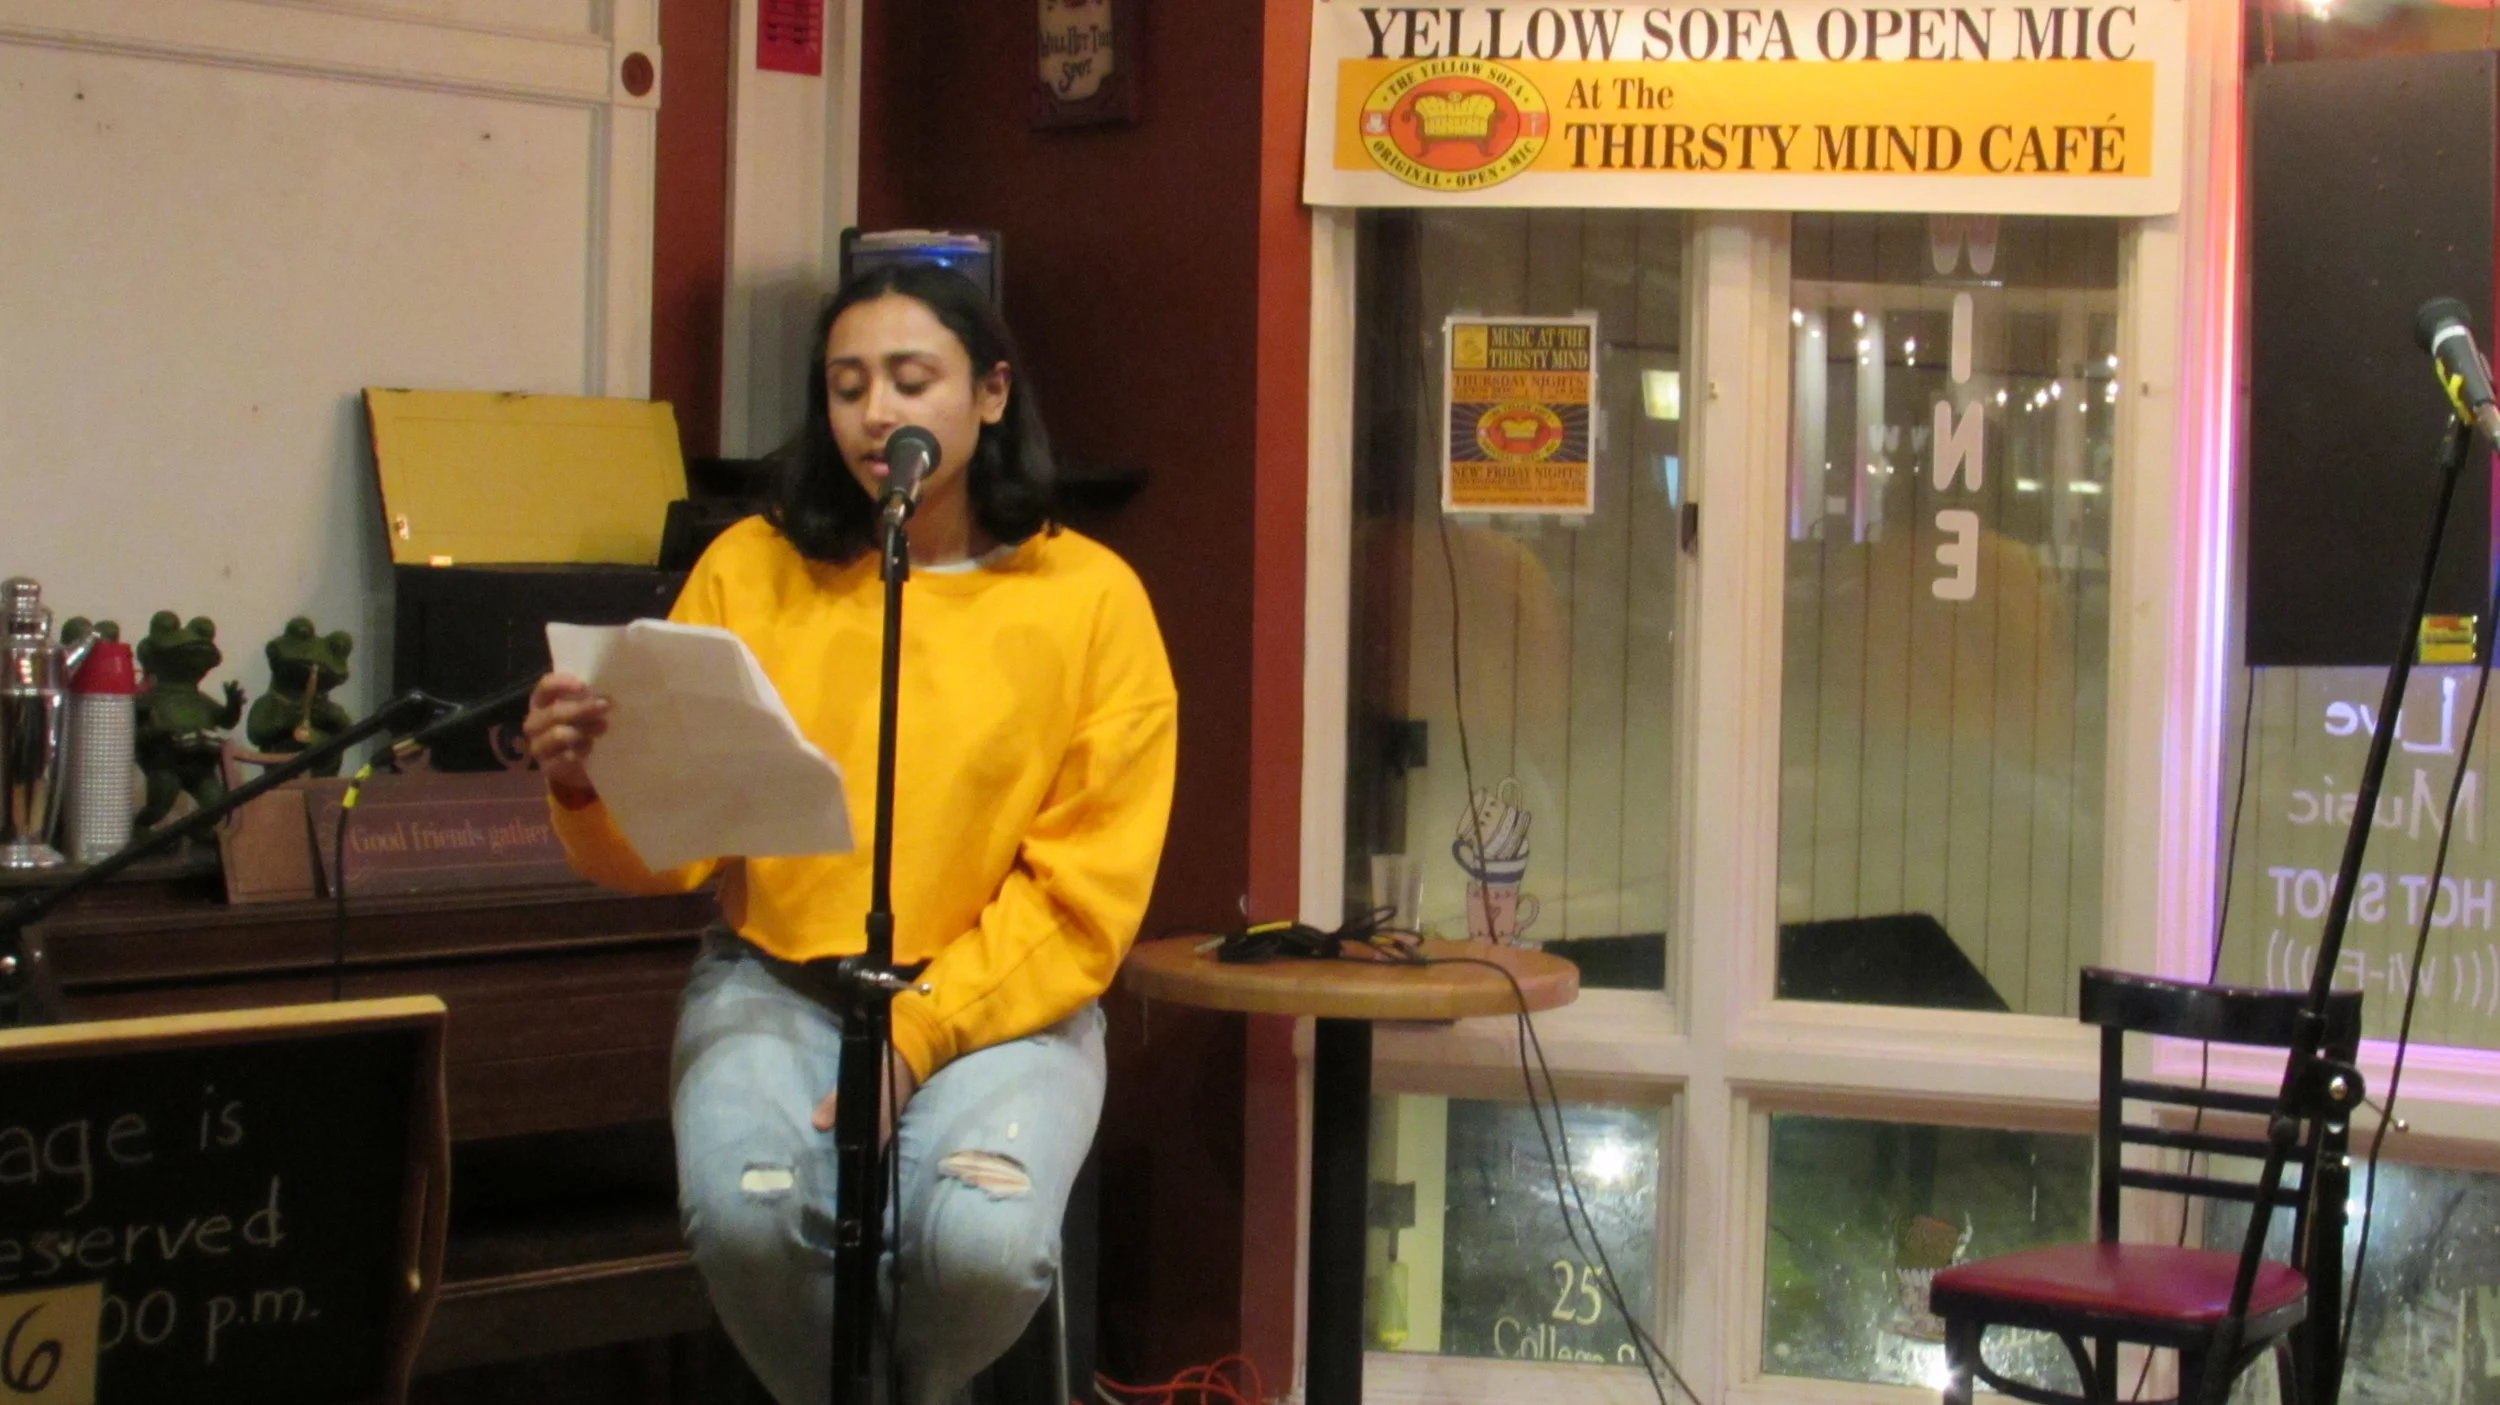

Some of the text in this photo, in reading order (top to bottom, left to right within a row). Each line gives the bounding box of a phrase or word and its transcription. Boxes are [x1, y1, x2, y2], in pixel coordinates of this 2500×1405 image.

[1360, 6, 2135, 61] YELLOW SOFA OPEN MIC
[1387, 59, 1525, 97] THE YELLOW SOFA
[1565, 78, 1675, 110] At The
[1373, 140, 1536, 188] ORIGINAL OPEN MIC
[1563, 113, 2126, 174] THIRSTY MIND CAFÉ
[1489, 348, 1589, 369] THIRSTY MIND
[1491, 327, 1587, 348] MUSIC AT THE
[1485, 465, 1531, 479] FRIDAY
[351, 822, 406, 853] Good
[487, 816, 550, 855] gather
[200, 1083, 244, 1150] is
[1552, 1259, 1603, 1326] 25
[3, 1301, 62, 1394] 6
[208, 1287, 320, 1362] p.m.
